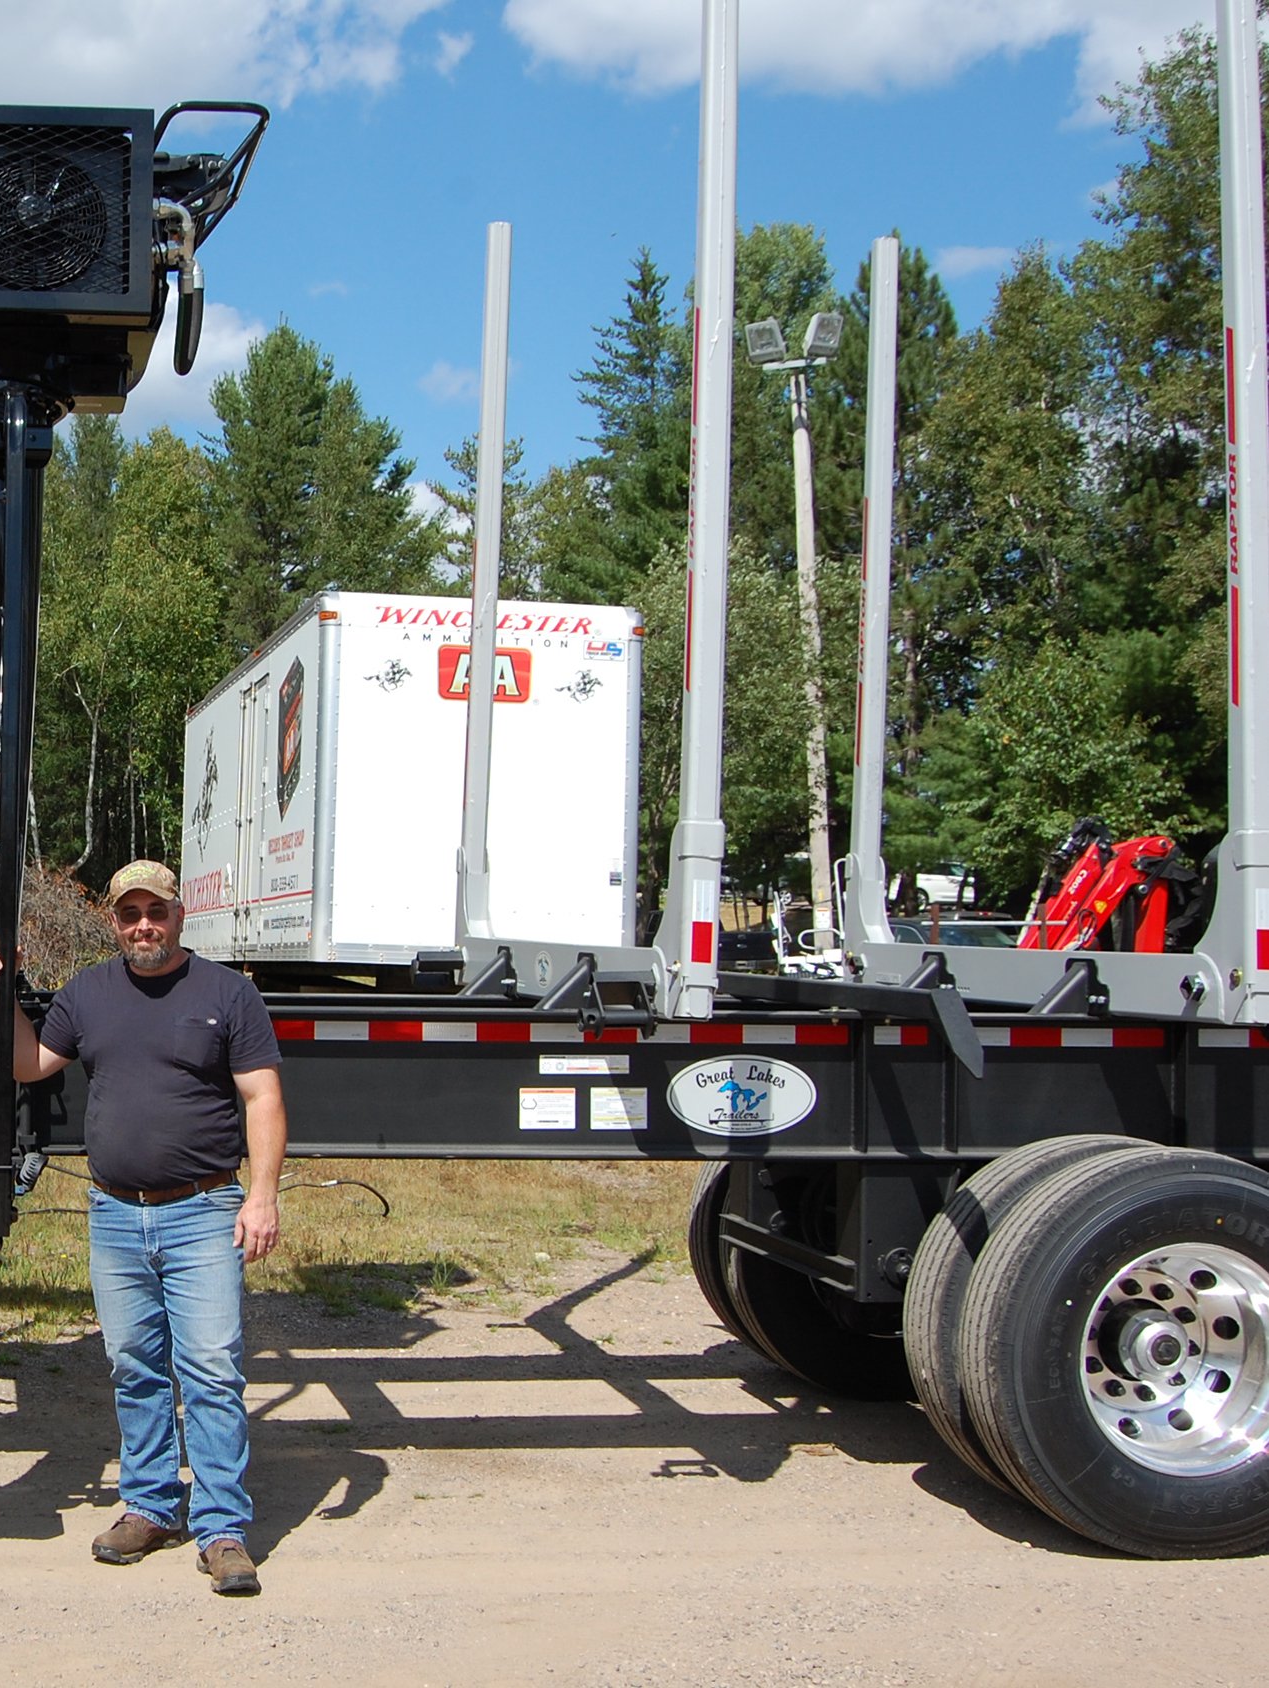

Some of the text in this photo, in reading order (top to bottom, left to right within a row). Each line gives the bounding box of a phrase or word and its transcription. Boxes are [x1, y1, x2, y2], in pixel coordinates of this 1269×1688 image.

[1227, 452, 1239, 575] RAPTOR
[375, 605, 594, 635] WINCESTER
[403, 632, 569, 649] AMMUITION
[695, 1065, 786, 1089] Great Lakes
[713, 1108, 760, 1120] Trailers
